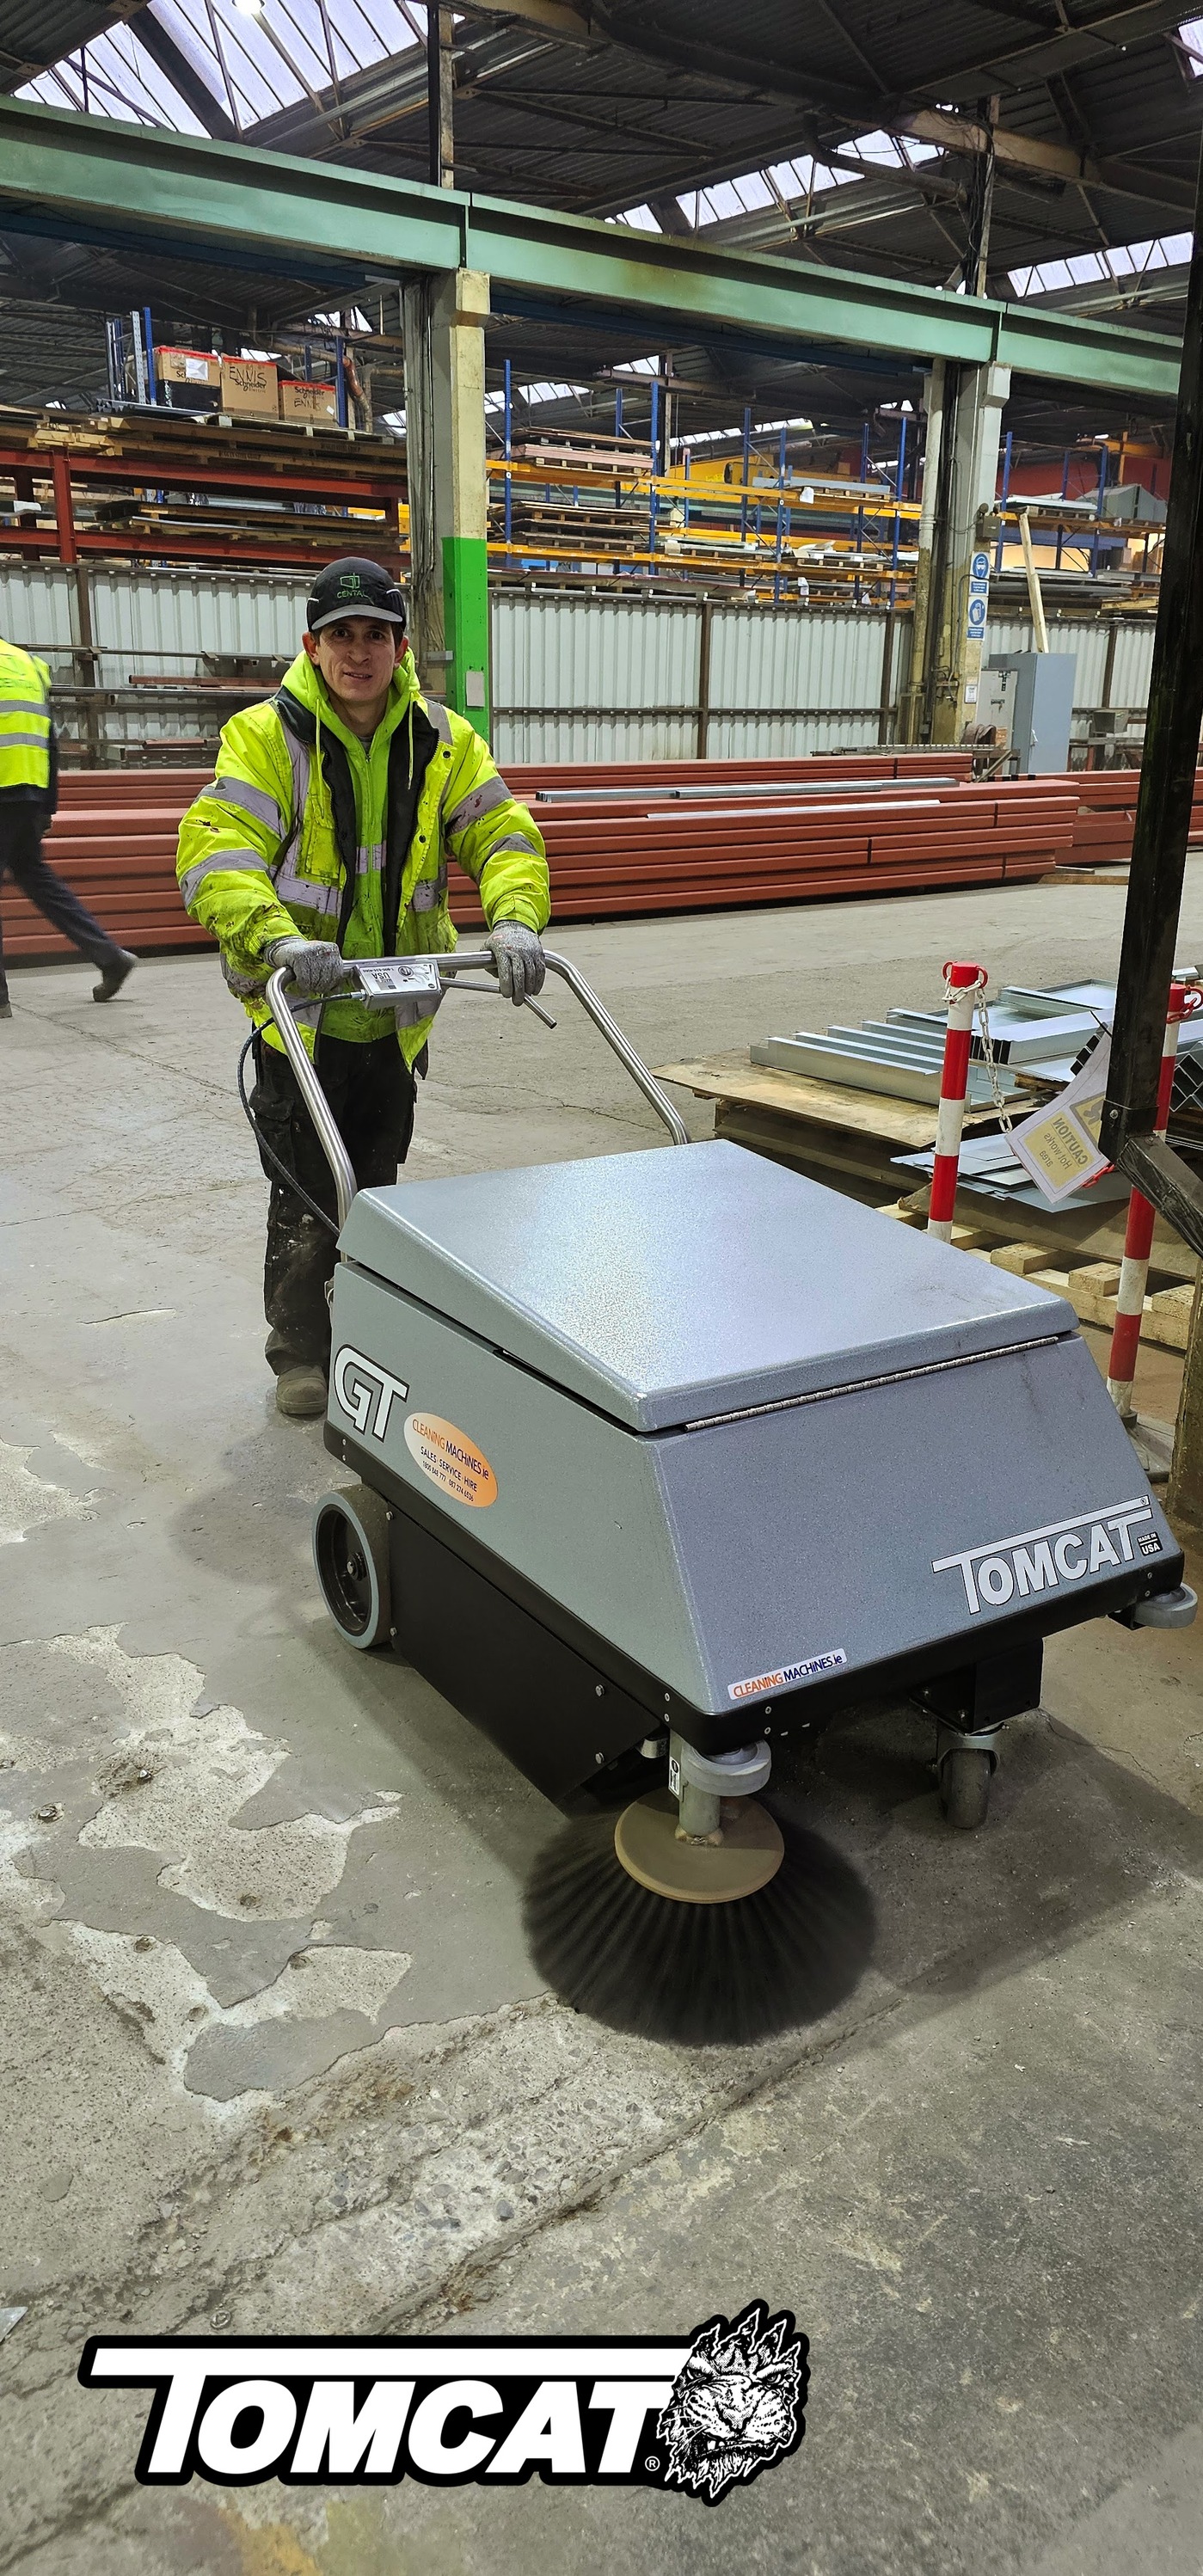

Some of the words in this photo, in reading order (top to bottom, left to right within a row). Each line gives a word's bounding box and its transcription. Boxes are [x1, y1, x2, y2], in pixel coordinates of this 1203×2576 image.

[229, 366, 267, 387] ENNIS
[336, 589, 369, 599] CENTAL
[333, 1343, 410, 1443] GT
[420, 1446, 437, 1463] SALES
[439, 1458, 462, 1481] SERVICE
[464, 1475, 478, 1493] HIRE
[931, 1494, 1153, 1615] TOMCAT
[1141, 1543, 1161, 1555] USA
